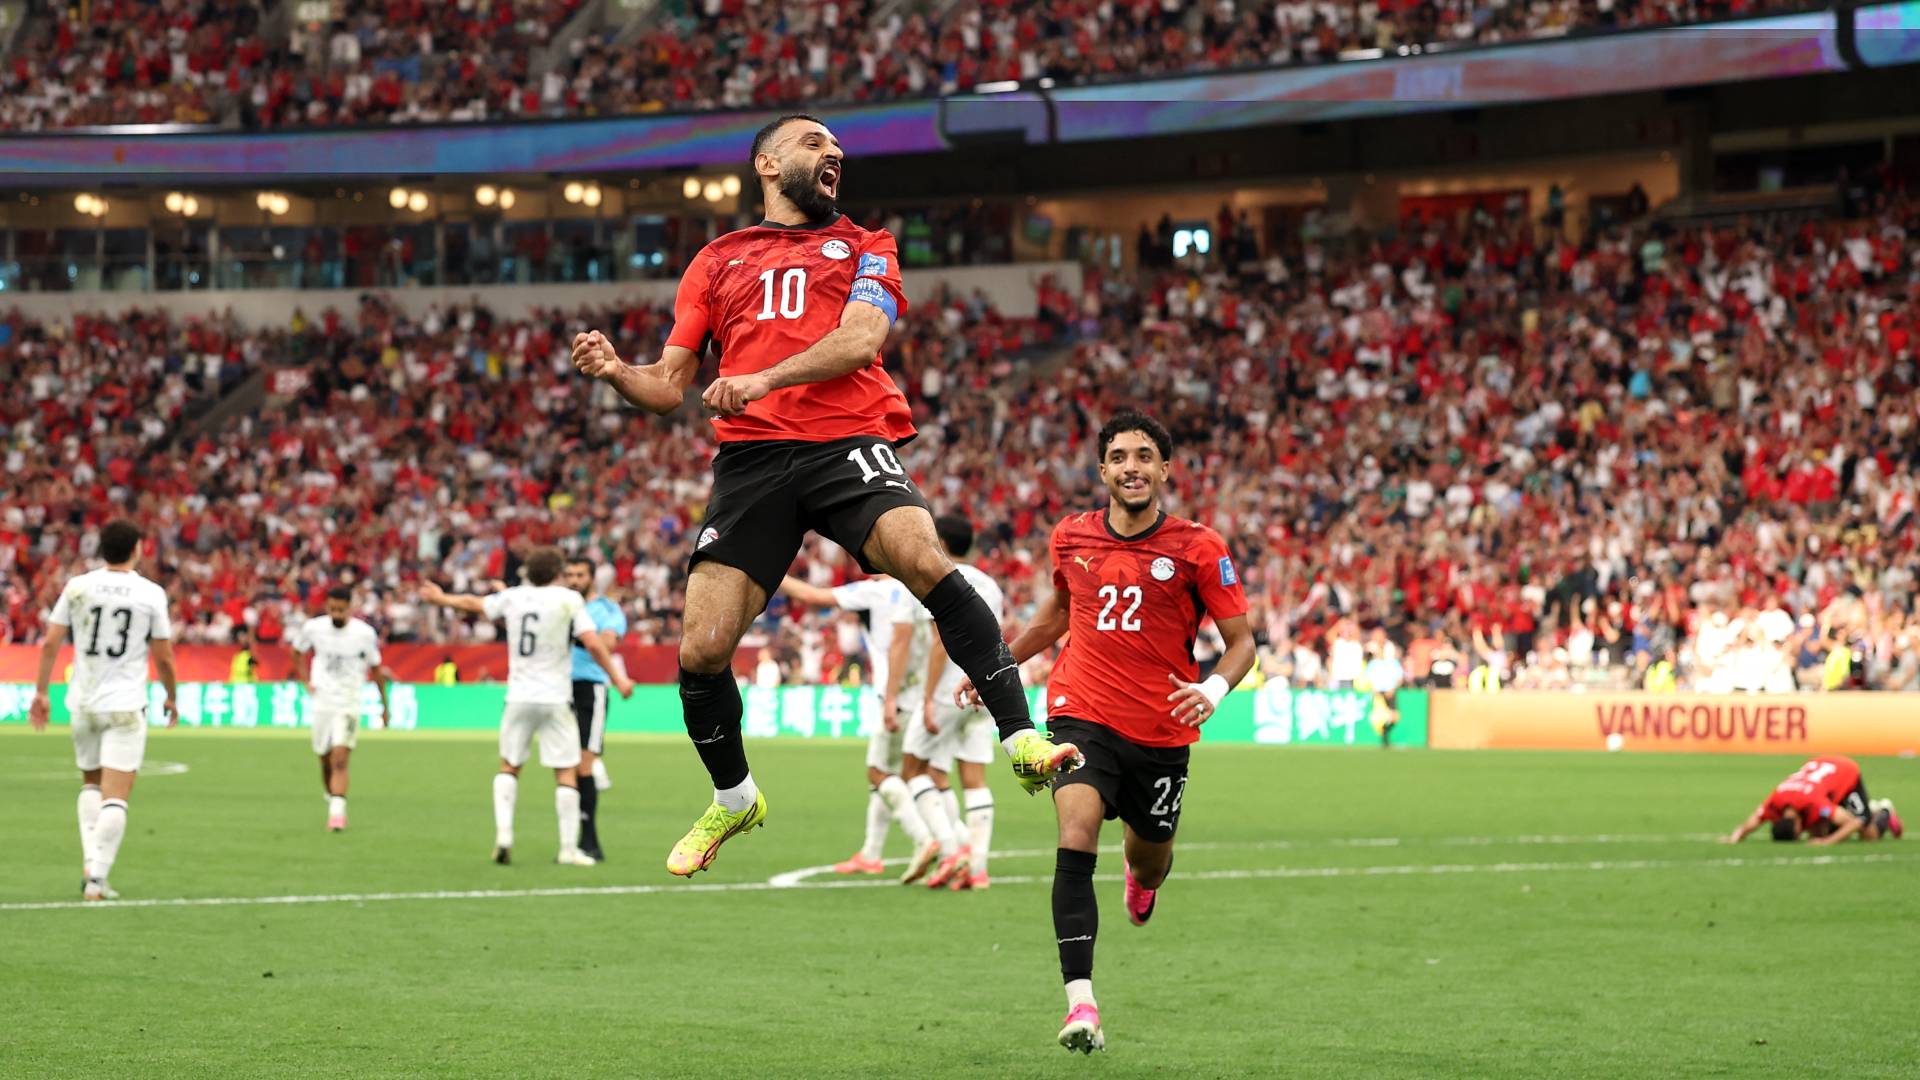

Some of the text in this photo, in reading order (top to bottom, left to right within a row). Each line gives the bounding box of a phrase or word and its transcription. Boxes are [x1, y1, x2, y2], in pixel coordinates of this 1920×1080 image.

[756, 268, 807, 321] 10
[847, 443, 904, 484] 10
[1096, 585, 1143, 631] 22
[86, 605, 133, 658] 13
[519, 612, 539, 658] 6
[1596, 704, 1808, 741] VANCOUVER
